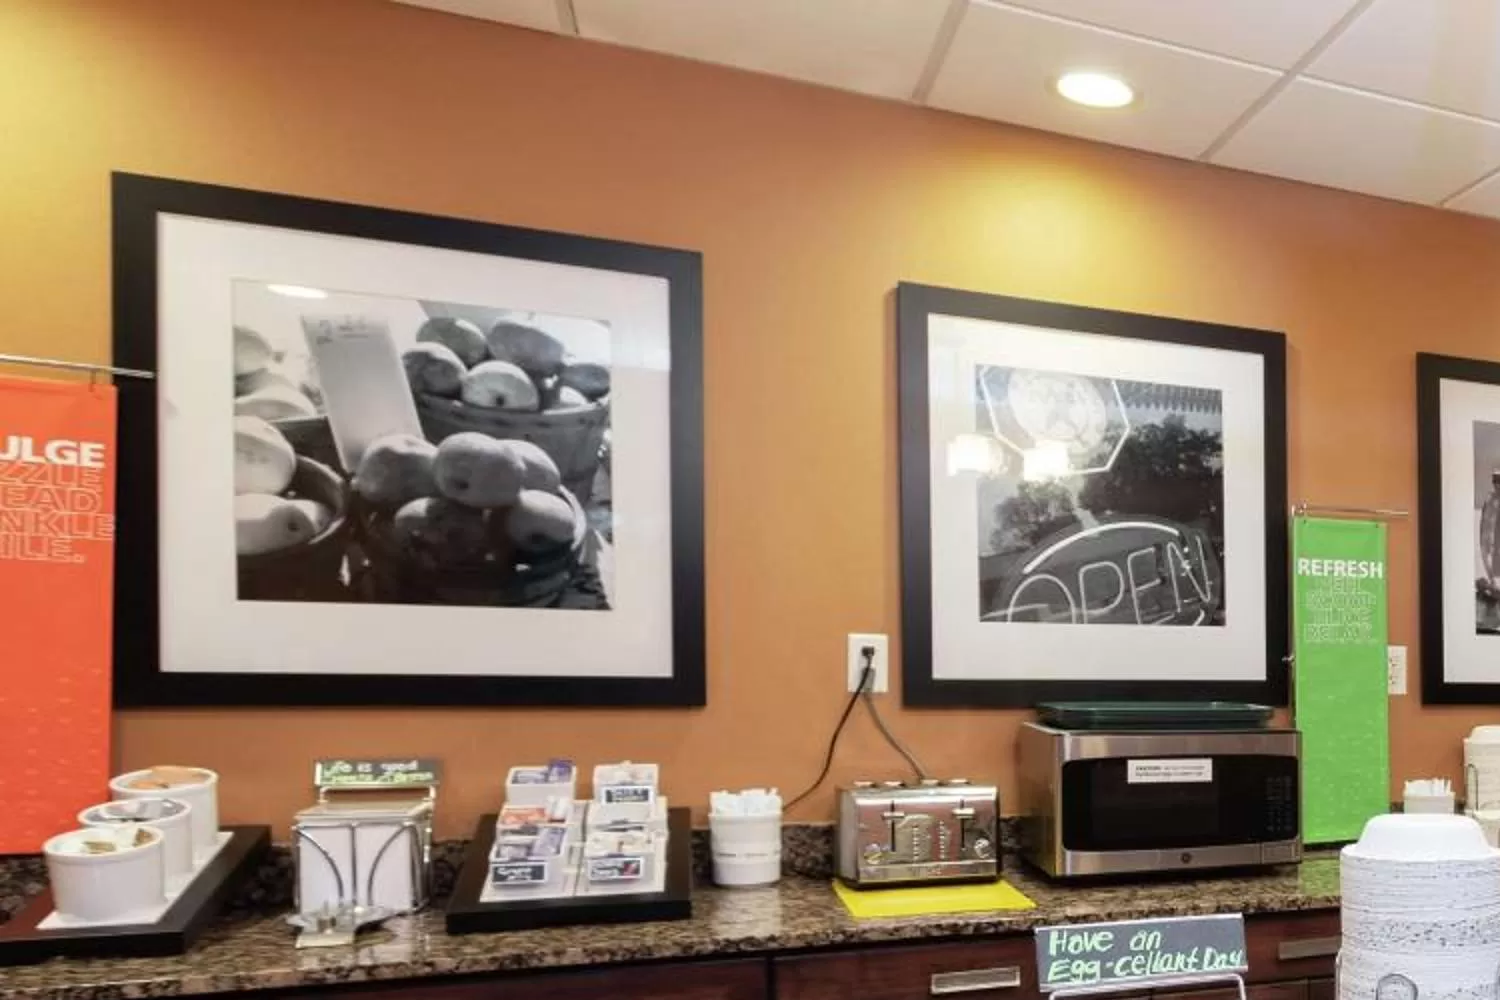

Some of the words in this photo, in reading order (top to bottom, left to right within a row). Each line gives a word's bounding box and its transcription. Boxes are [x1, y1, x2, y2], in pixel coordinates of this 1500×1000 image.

[1297, 557, 1384, 579] REFRESH
[1050, 929, 1115, 957] Have
[1129, 929, 1161, 951] an
[1202, 947, 1244, 971] Day
